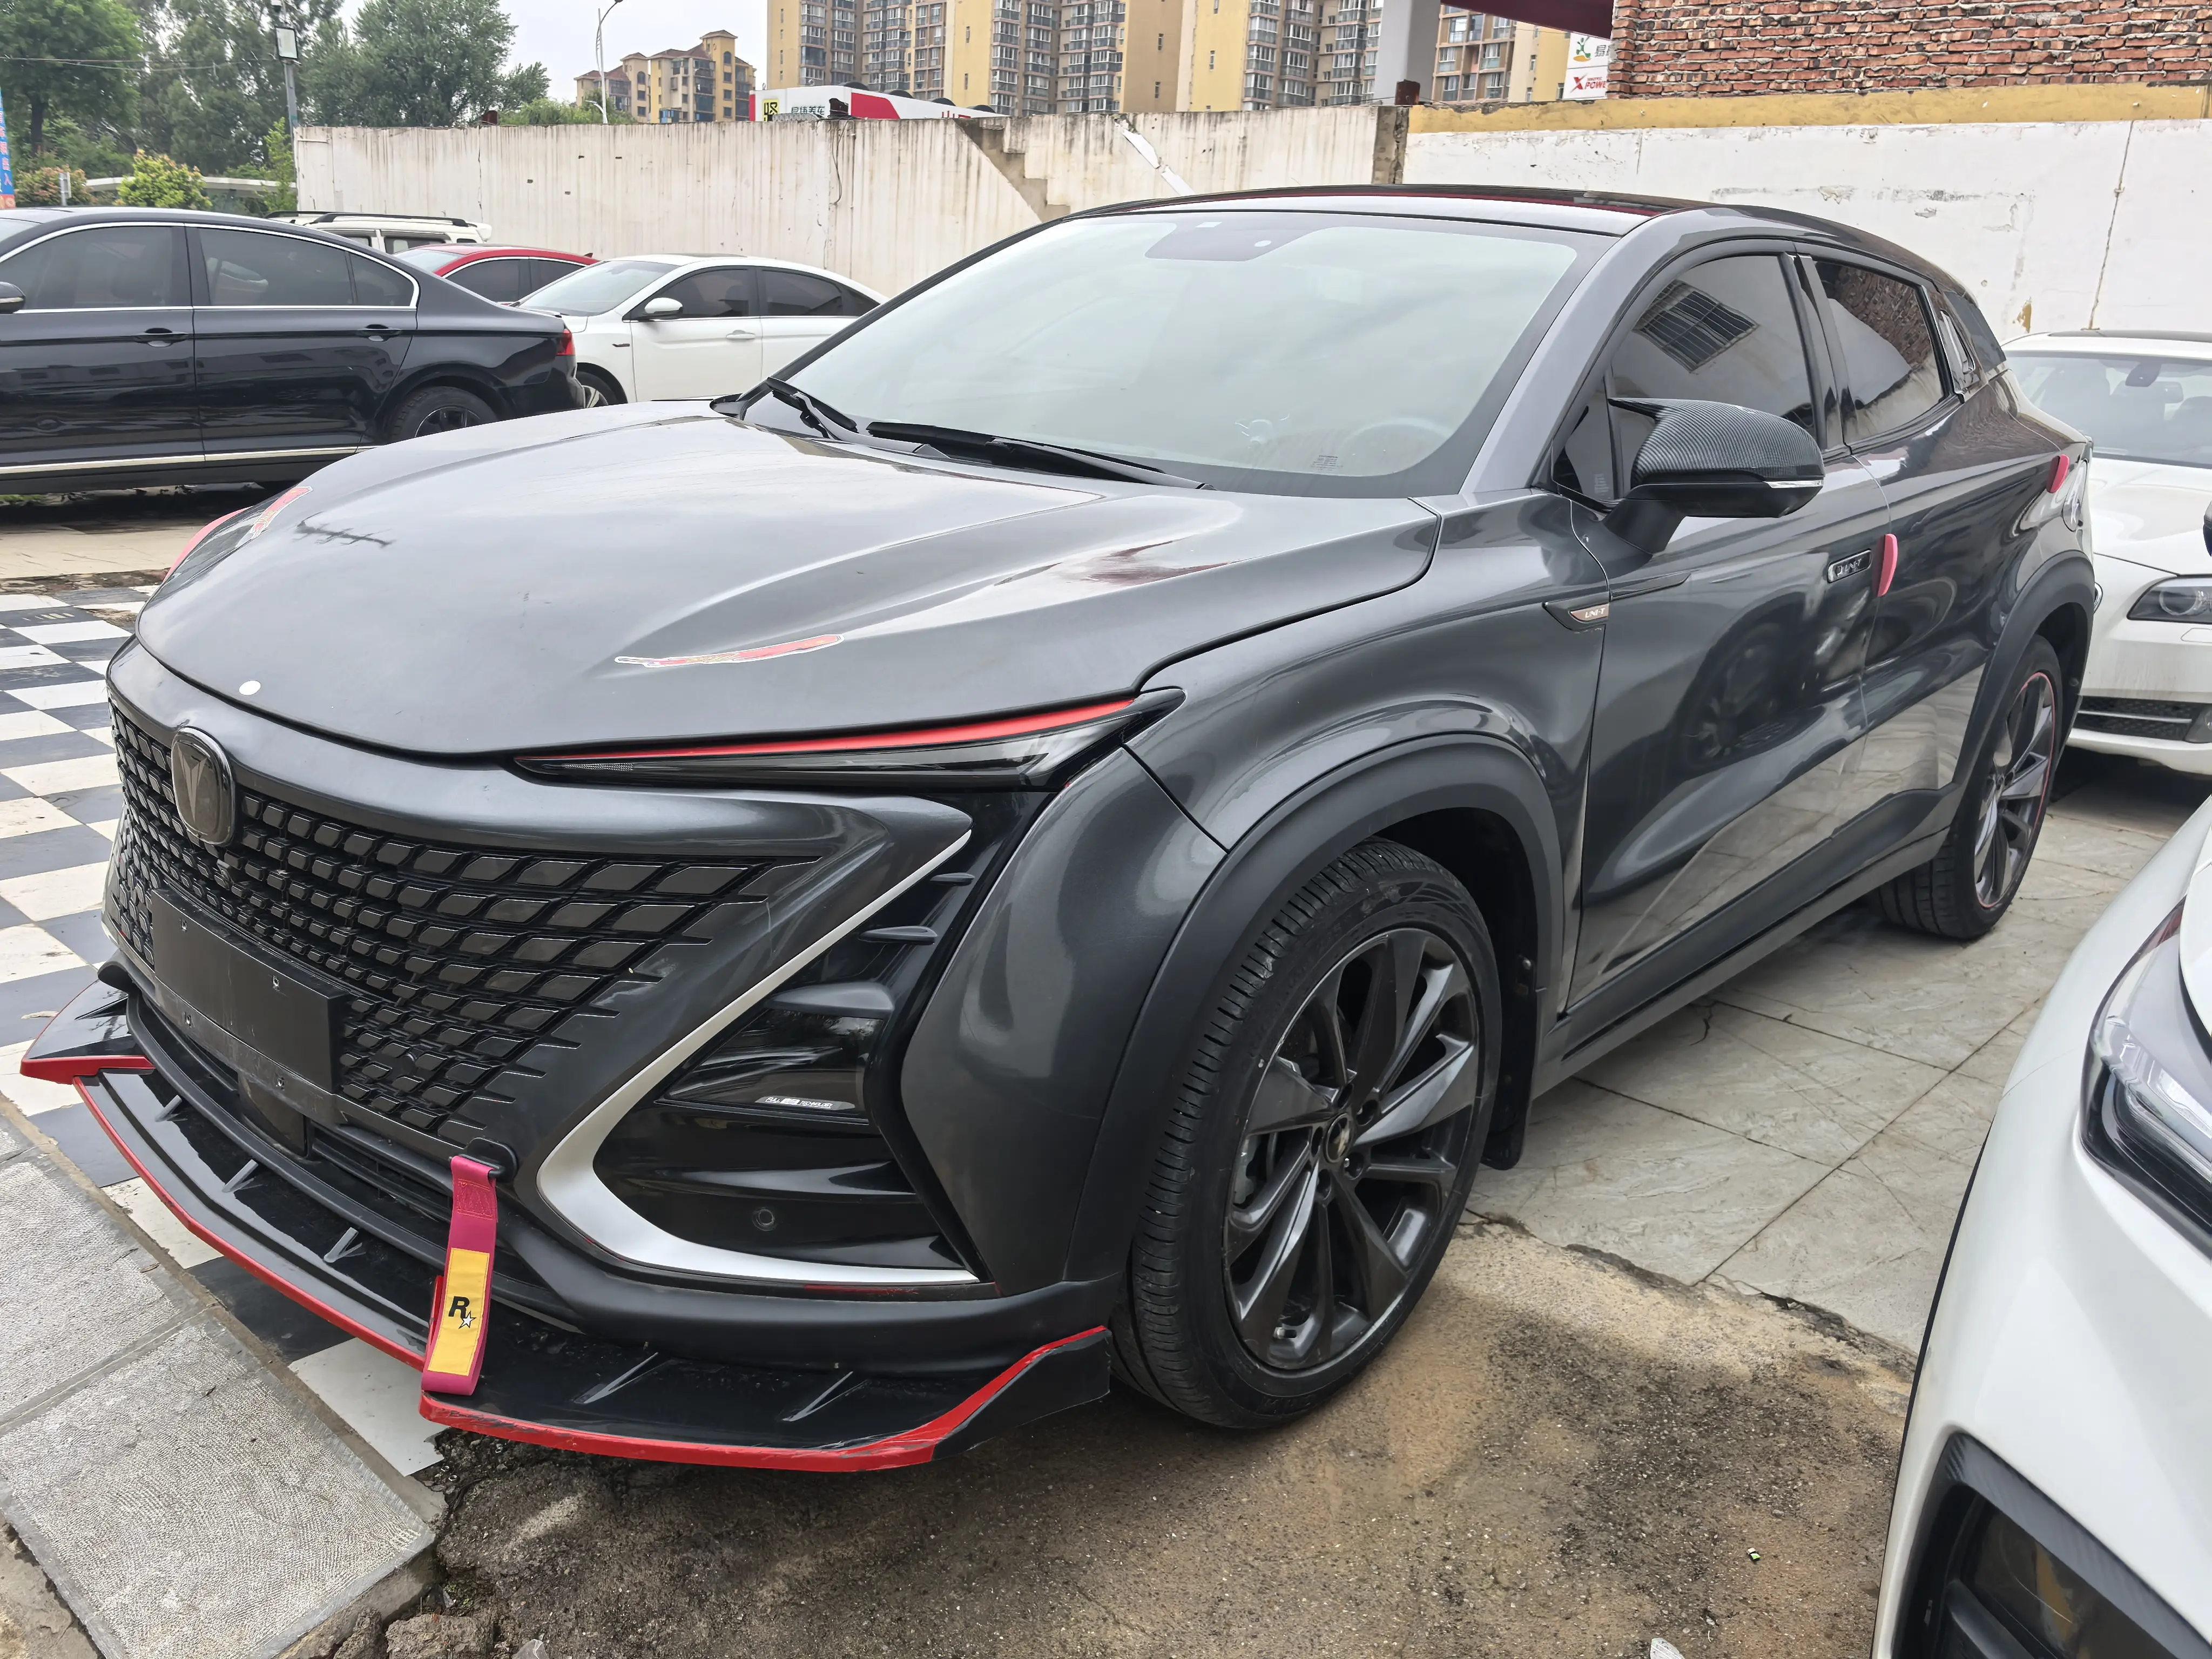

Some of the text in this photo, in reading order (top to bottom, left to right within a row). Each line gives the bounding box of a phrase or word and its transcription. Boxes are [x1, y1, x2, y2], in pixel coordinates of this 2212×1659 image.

[1584, 81, 1606, 90] POWE
[1585, 608, 1605, 618] UNI-T
[448, 1296, 470, 1319] R
